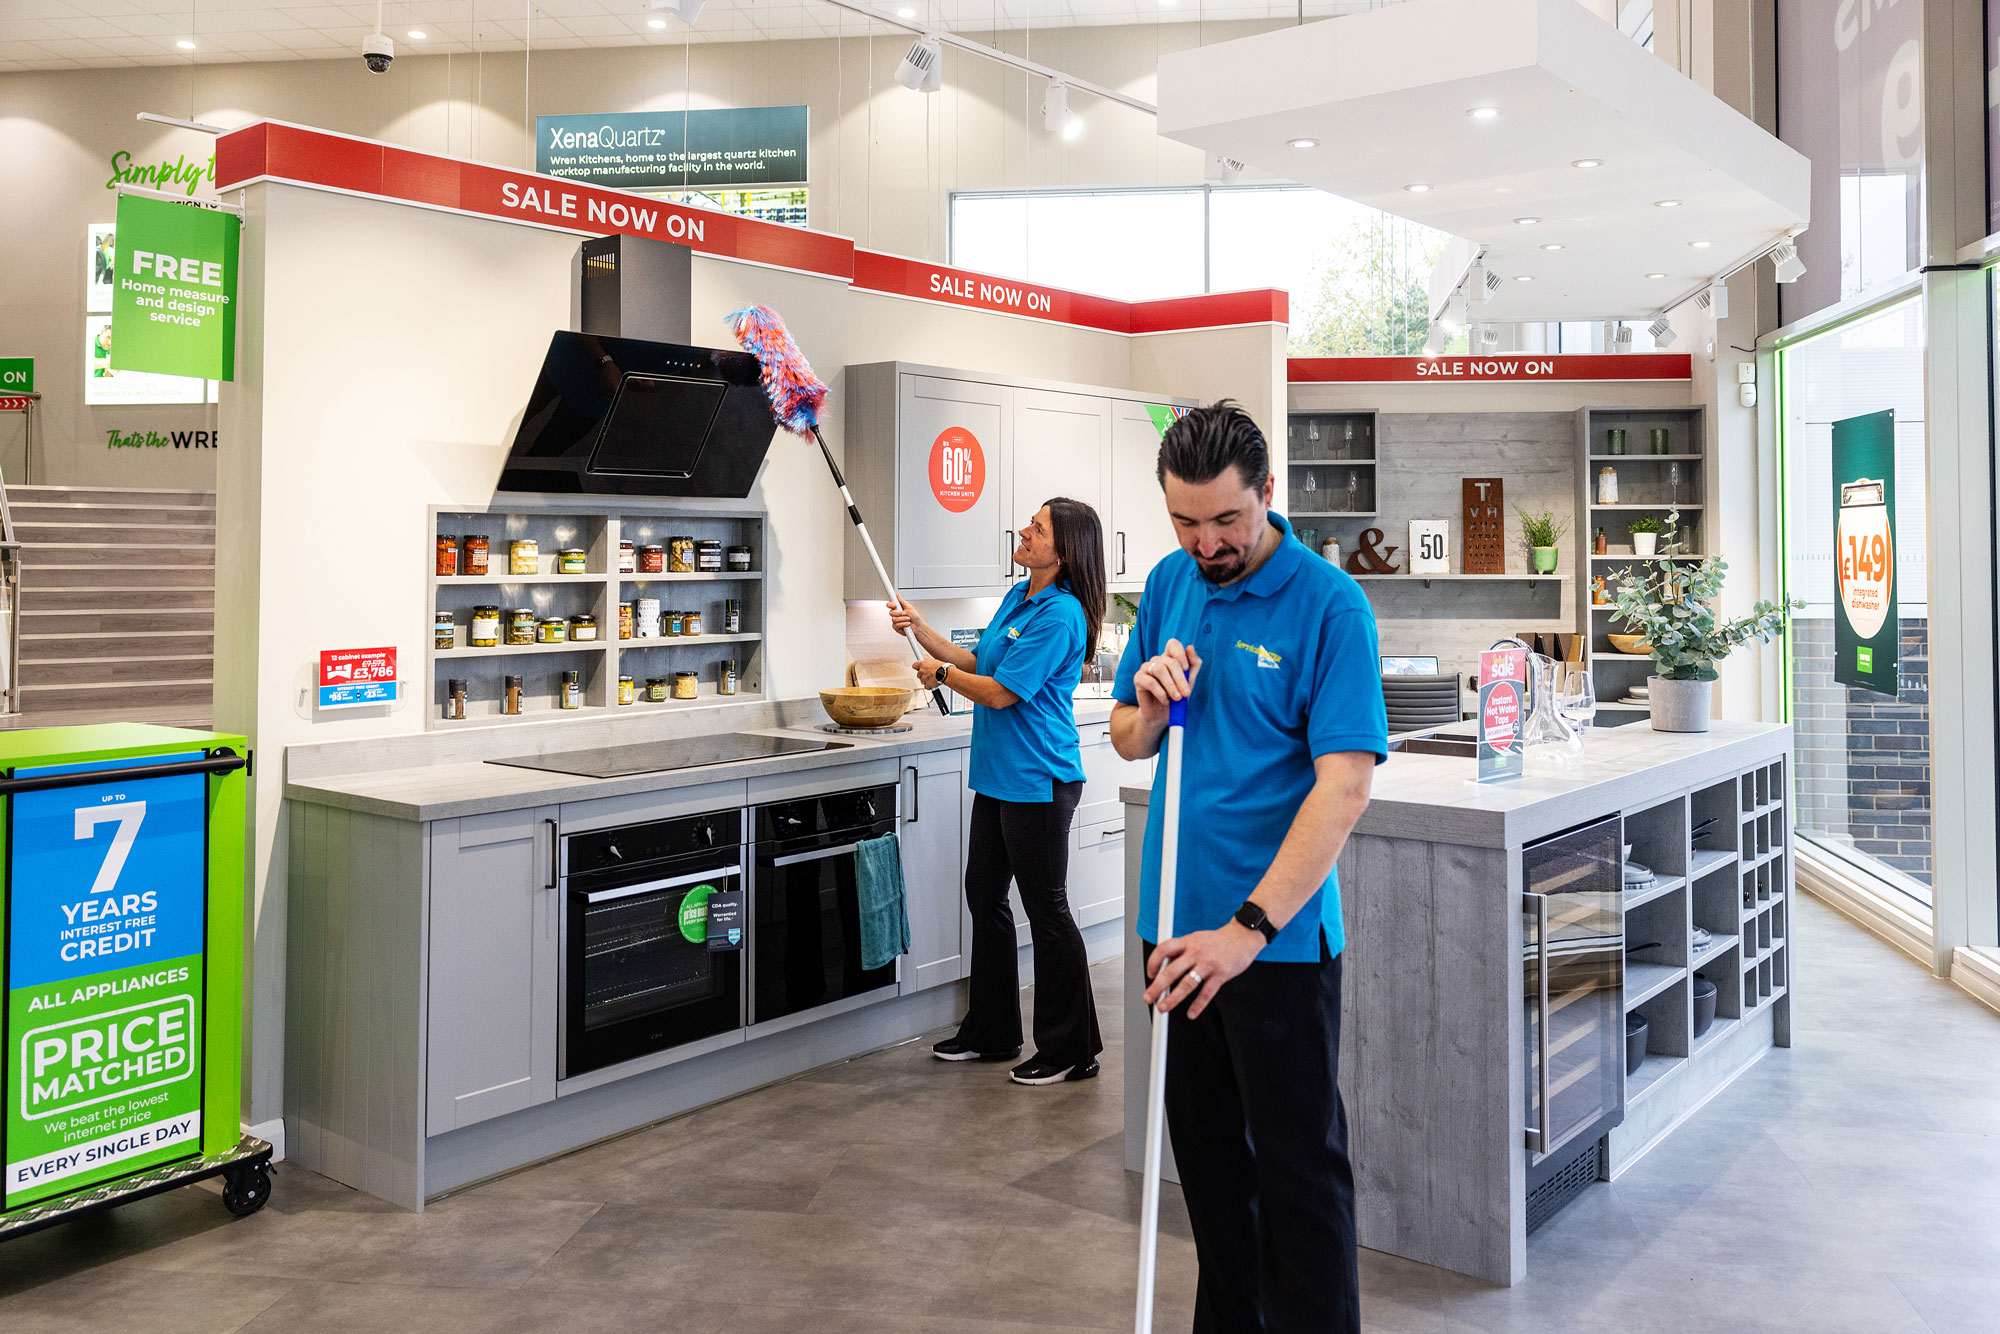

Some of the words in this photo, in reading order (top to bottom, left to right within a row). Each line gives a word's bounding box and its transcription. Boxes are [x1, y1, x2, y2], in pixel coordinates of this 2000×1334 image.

[549, 167, 591, 177] worktop
[593, 164, 666, 175] manufacturing
[668, 162, 701, 174] facility
[703, 162, 713, 172] in
[715, 161, 732, 171] the
[735, 160, 766, 170] world.
[550, 155, 576, 165] Wren
[579, 154, 623, 165] Kitchens,
[625, 153, 654, 163] home
[656, 153, 666, 162] to
[669, 151, 685, 161] the
[687, 151, 722, 162] largest
[724, 150, 757, 161] quartz
[759, 148, 796, 158] kitchen
[106, 150, 206, 196] Simply
[502, 182, 577, 219] SALE
[588, 198, 658, 233] NOW
[666, 214, 704, 242] ON
[132, 249, 222, 287] FREE
[121, 278, 165, 295] Home
[169, 285, 230, 304] measure
[930, 273, 974, 299] SALE
[980, 282, 1023, 308] NOW
[1027, 291, 1051, 313] ON
[136, 293, 164, 309] and
[168, 296, 215, 316] design
[150, 309, 201, 327] service
[4, 371, 26, 384] ON
[1416, 362, 1464, 377] SALE
[1470, 361, 1518, 376] NOW
[1525, 360, 1554, 375] ON
[171, 430, 218, 449] WRE
[942, 446, 973, 485] 60%
[1474, 482, 1491, 502] T
[1420, 533, 1444, 560] 50
[1843, 534, 1886, 583] £149
[1851, 598, 1880, 611] dishwasher
[1852, 585, 1879, 599] integrated
[338, 653, 360, 661] cabinet
[1491, 655, 1515, 678] sale
[353, 666, 394, 680] £3,786
[1487, 706, 1498, 717] Hot
[1499, 704, 1517, 714] Water
[1491, 695, 1513, 706] Instant
[1494, 716, 1510, 726] Taps
[102, 795, 114, 803] UP
[115, 793, 126, 801] TO
[74, 800, 147, 894] 7
[61, 890, 158, 925] YEARS
[60, 920, 121, 941] INTEREST
[125, 914, 156, 929] FREE
[60, 928, 156, 962] CREDIT
[28, 997, 67, 1013] ALL
[70, 967, 189, 1005] APPLIANCES
[34, 1007, 185, 1078] PRICE
[32, 1046, 186, 1105] MATCHED
[44, 1119, 67, 1134] We
[70, 1112, 101, 1128] beat
[103, 1105, 125, 1120] the
[129, 1091, 169, 1111] lowest
[63, 1120, 117, 1143] internet
[120, 1110, 152, 1129] price
[18, 1153, 81, 1183] EVERY
[85, 1132, 150, 1163] SINGLE
[155, 1120, 192, 1142] DAY
